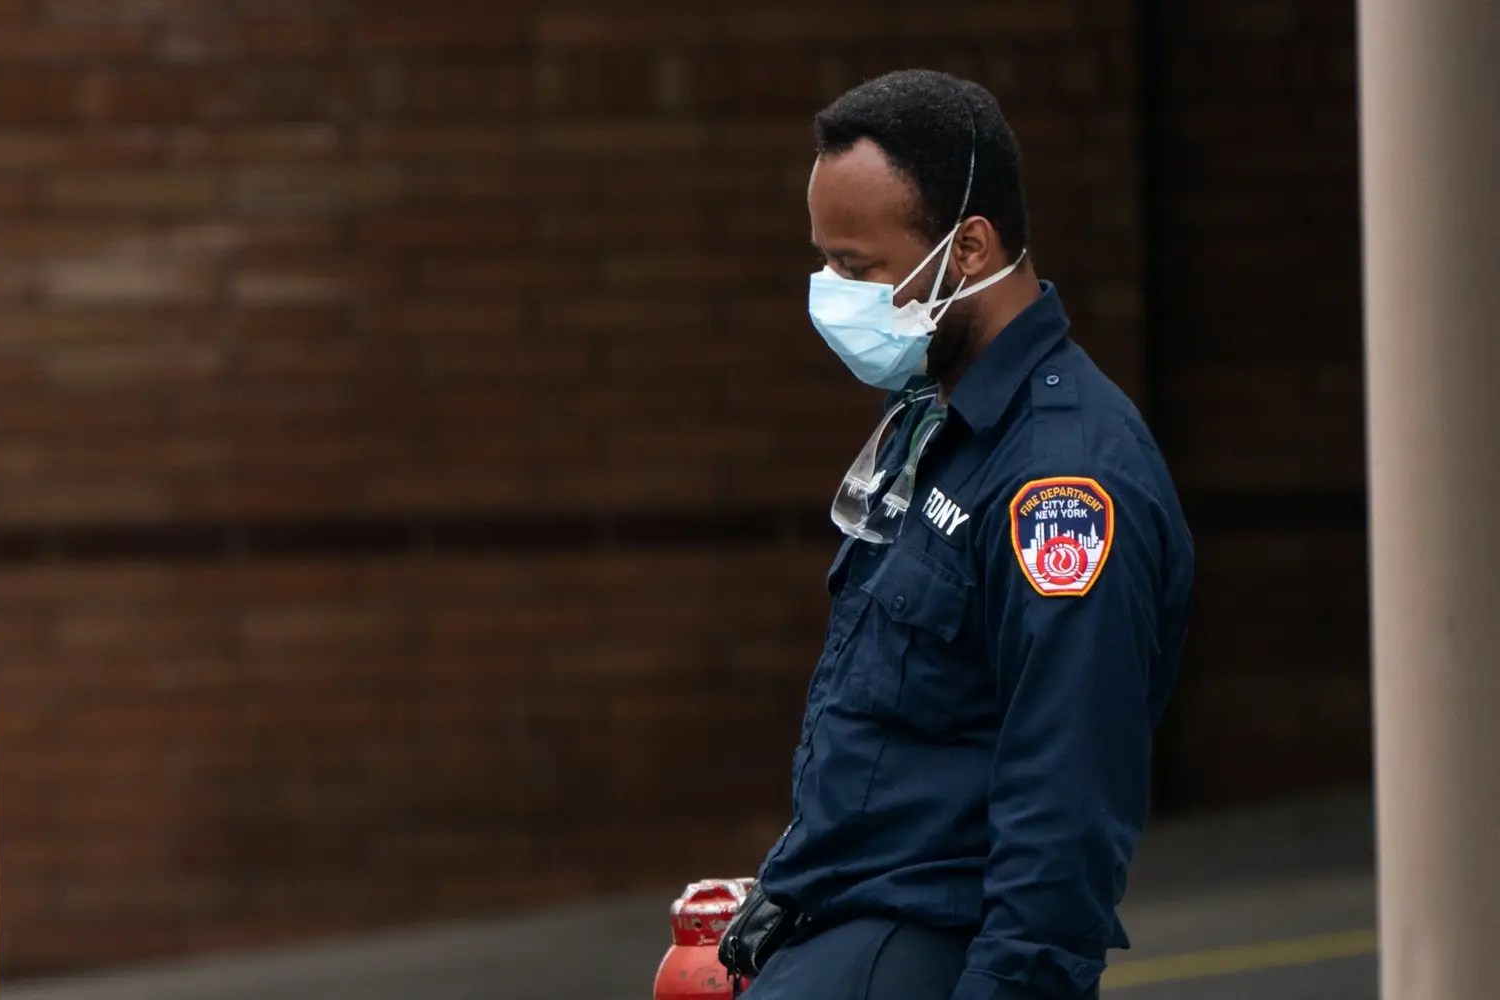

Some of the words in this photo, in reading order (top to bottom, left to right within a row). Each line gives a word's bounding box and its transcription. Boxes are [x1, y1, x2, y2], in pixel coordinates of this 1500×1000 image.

[922, 487, 970, 536] FDNY
[1020, 495, 1040, 516] FIRE
[1040, 486, 1104, 512] DEPARTMENT
[1042, 499, 1065, 510] CITY
[1067, 499, 1080, 509] OF
[1035, 509, 1058, 520] NEW
[1061, 508, 1088, 519] YORK
